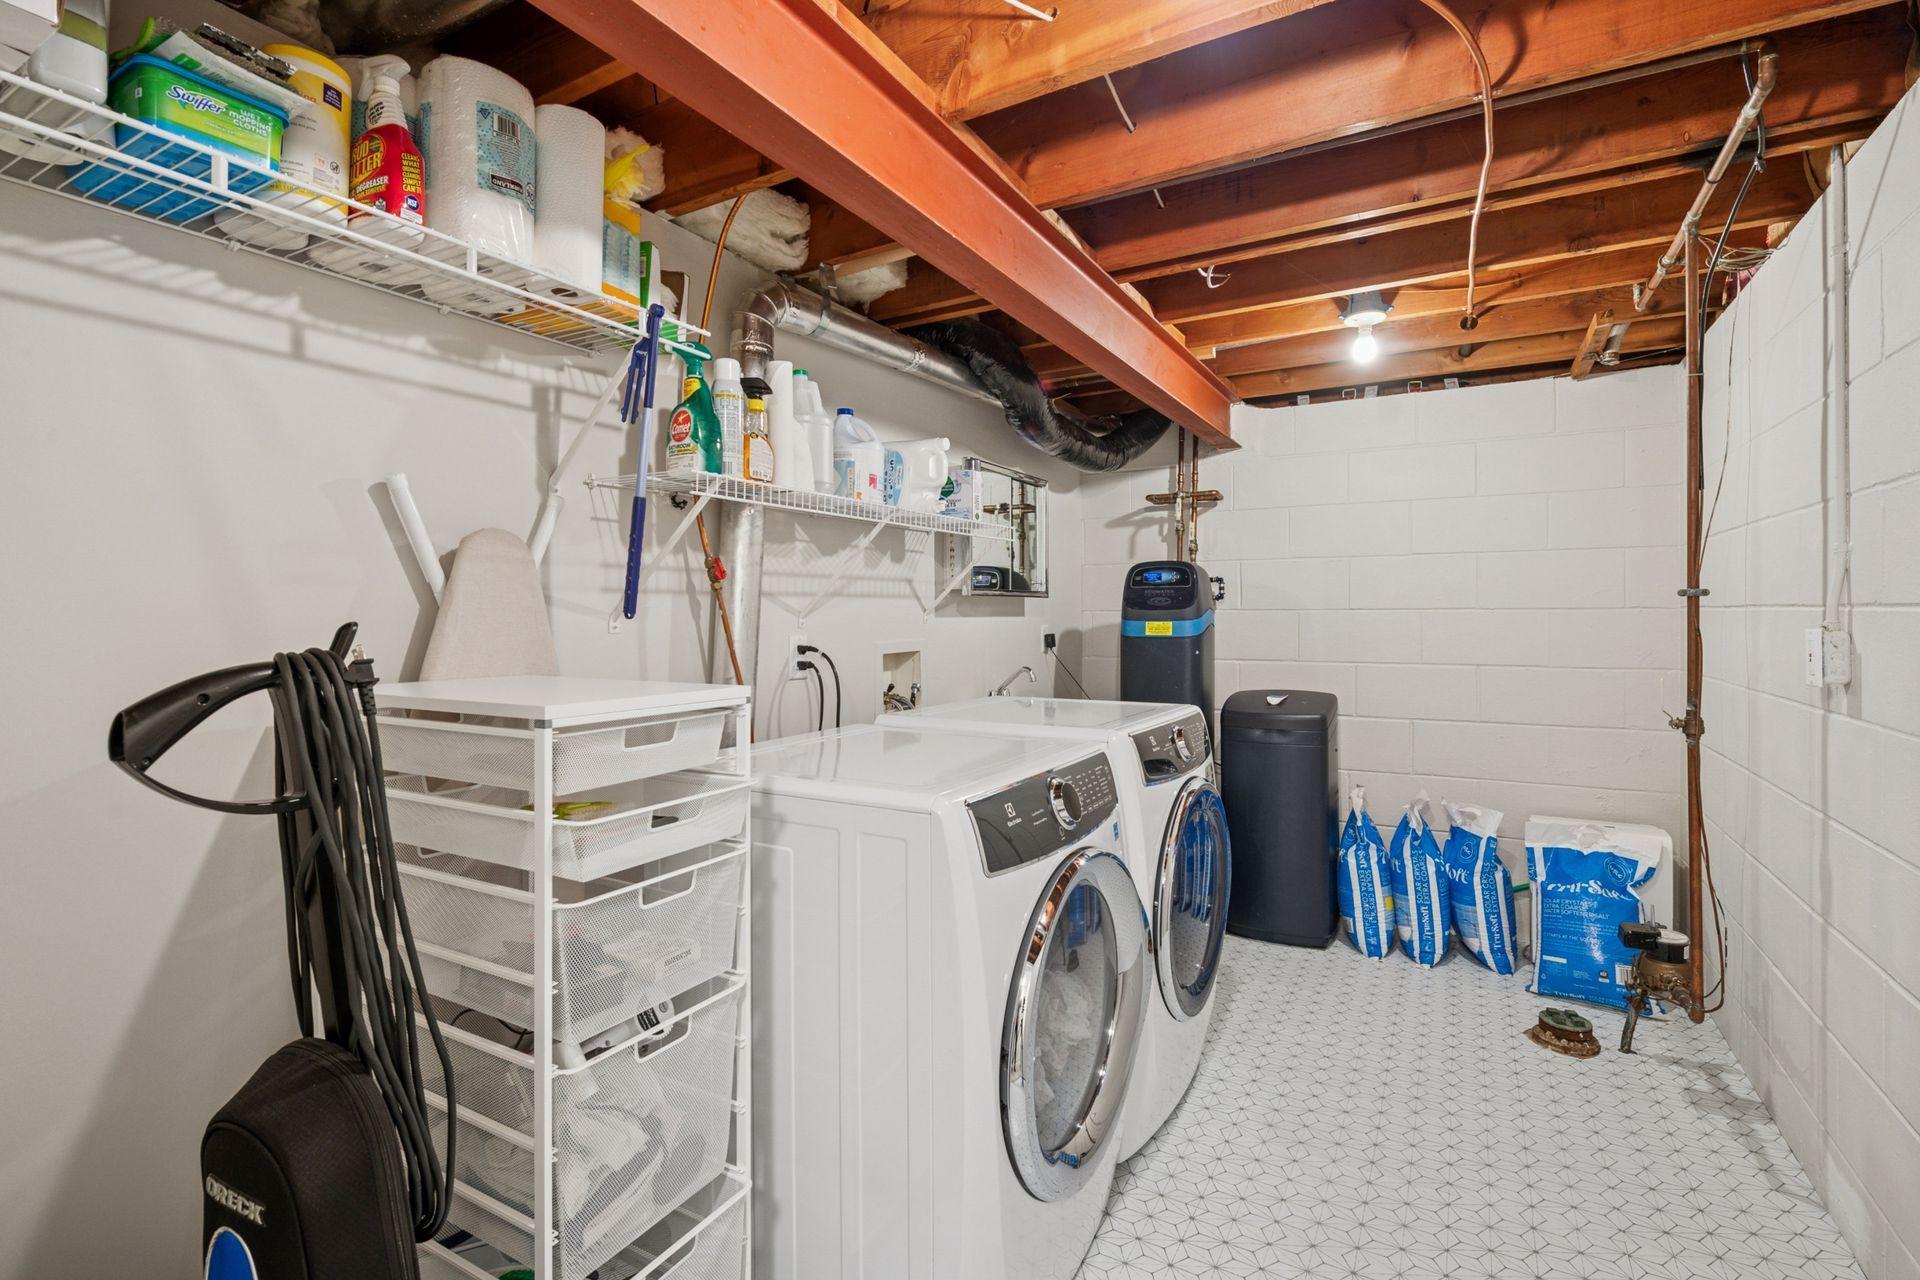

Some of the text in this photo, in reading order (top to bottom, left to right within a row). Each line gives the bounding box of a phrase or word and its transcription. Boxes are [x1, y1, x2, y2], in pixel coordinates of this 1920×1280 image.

[166, 86, 225, 114] Swiffer
[229, 111, 272, 132] MOPPING
[240, 109, 261, 120] WET
[233, 119, 268, 137] CLOTHS
[350, 152, 382, 179] UTTER
[356, 175, 390, 193] DEGREASER
[1358, 869, 1367, 892] EXTRA
[1364, 869, 1374, 892] SOLAR
[1414, 881, 1424, 904] SOLAR
[1422, 882, 1431, 905] EXTRA
[1482, 890, 1492, 913] SOLAR
[1490, 889, 1499, 913] EXTRA
[205, 1175, 266, 1226] ORECK
